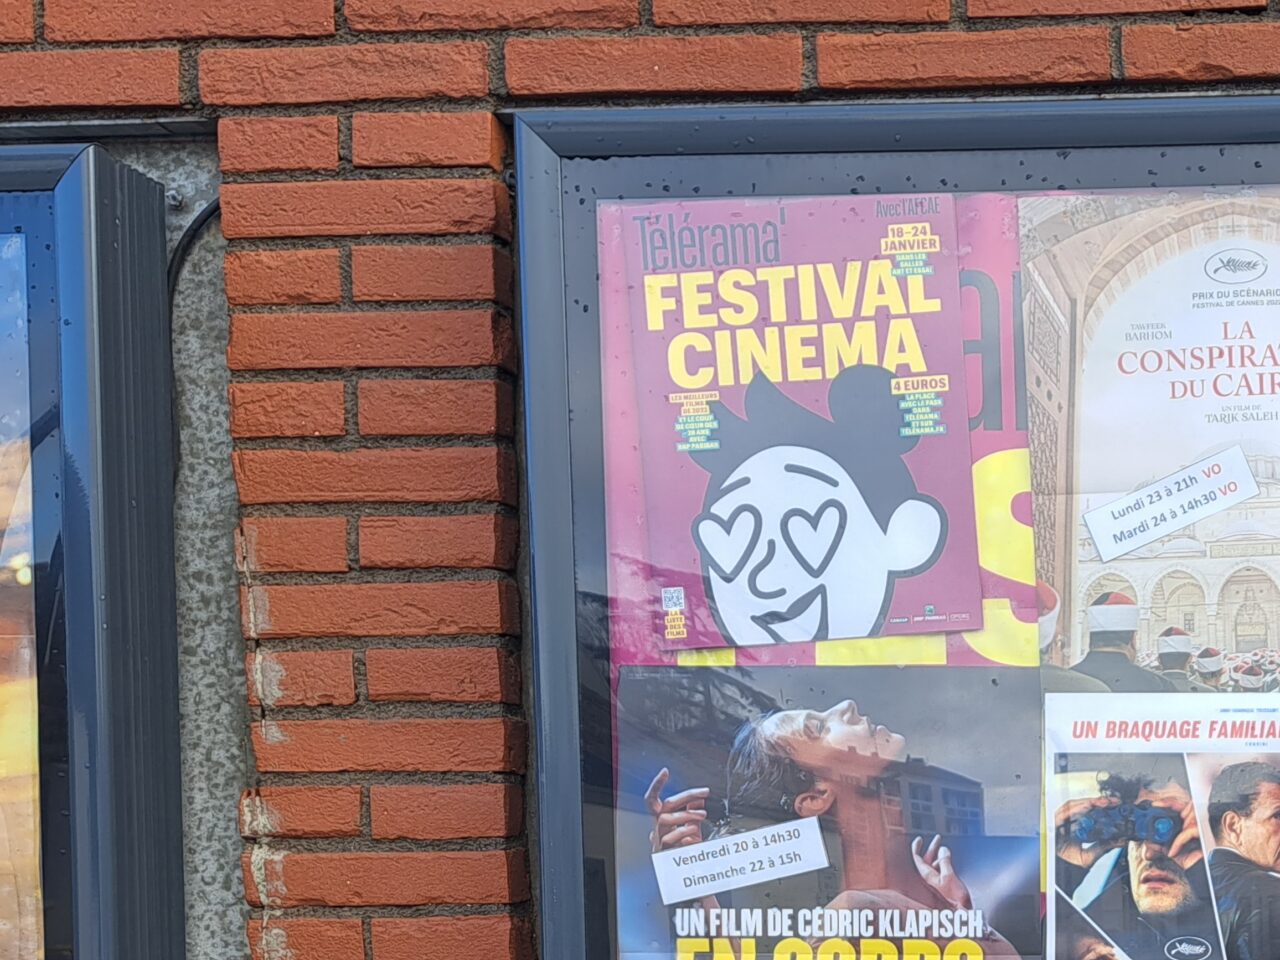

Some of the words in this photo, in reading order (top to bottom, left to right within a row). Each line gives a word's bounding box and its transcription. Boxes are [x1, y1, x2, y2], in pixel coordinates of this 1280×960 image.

[884, 239, 937, 252] JANVIER
[643, 259, 941, 331] FESTIVAL
[1192, 291, 1214, 300] PRIX
[1217, 290, 1230, 299] DU
[1222, 320, 1256, 340] LA
[667, 318, 928, 389] CINEMA
[893, 381, 901, 392] 4
[904, 378, 947, 391] EUROS
[1170, 379, 1206, 399] DU
[1204, 412, 1238, 425] TARIK
[1241, 411, 1278, 422] SALEH
[1110, 498, 1145, 520] Lundi
[1146, 490, 1162, 505] 23
[1164, 486, 1173, 497] à
[1174, 475, 1198, 492] 21h
[1201, 463, 1222, 478] VO
[1112, 519, 1150, 544] Mardi
[1151, 513, 1167, 528] 24
[1170, 508, 1178, 519] à
[1179, 490, 1217, 514] 14h30
[1218, 481, 1238, 496] VO
[1072, 720, 1098, 739] UN
[1105, 720, 1201, 740] BRAQUAGE
[673, 846, 731, 867] Vendredi
[734, 840, 749, 853] 20
[752, 838, 760, 848] à
[762, 828, 800, 847] 14h30
[683, 865, 746, 888] Dimanche
[750, 860, 765, 872] 22
[768, 857, 775, 868] à
[779, 852, 802, 866] 15h
[675, 908, 704, 937] UN
[710, 908, 763, 937] FILM
[767, 908, 794, 937] DE
[798, 905, 874, 937] CÉDRIC
[878, 909, 983, 937] KLAPISCH
